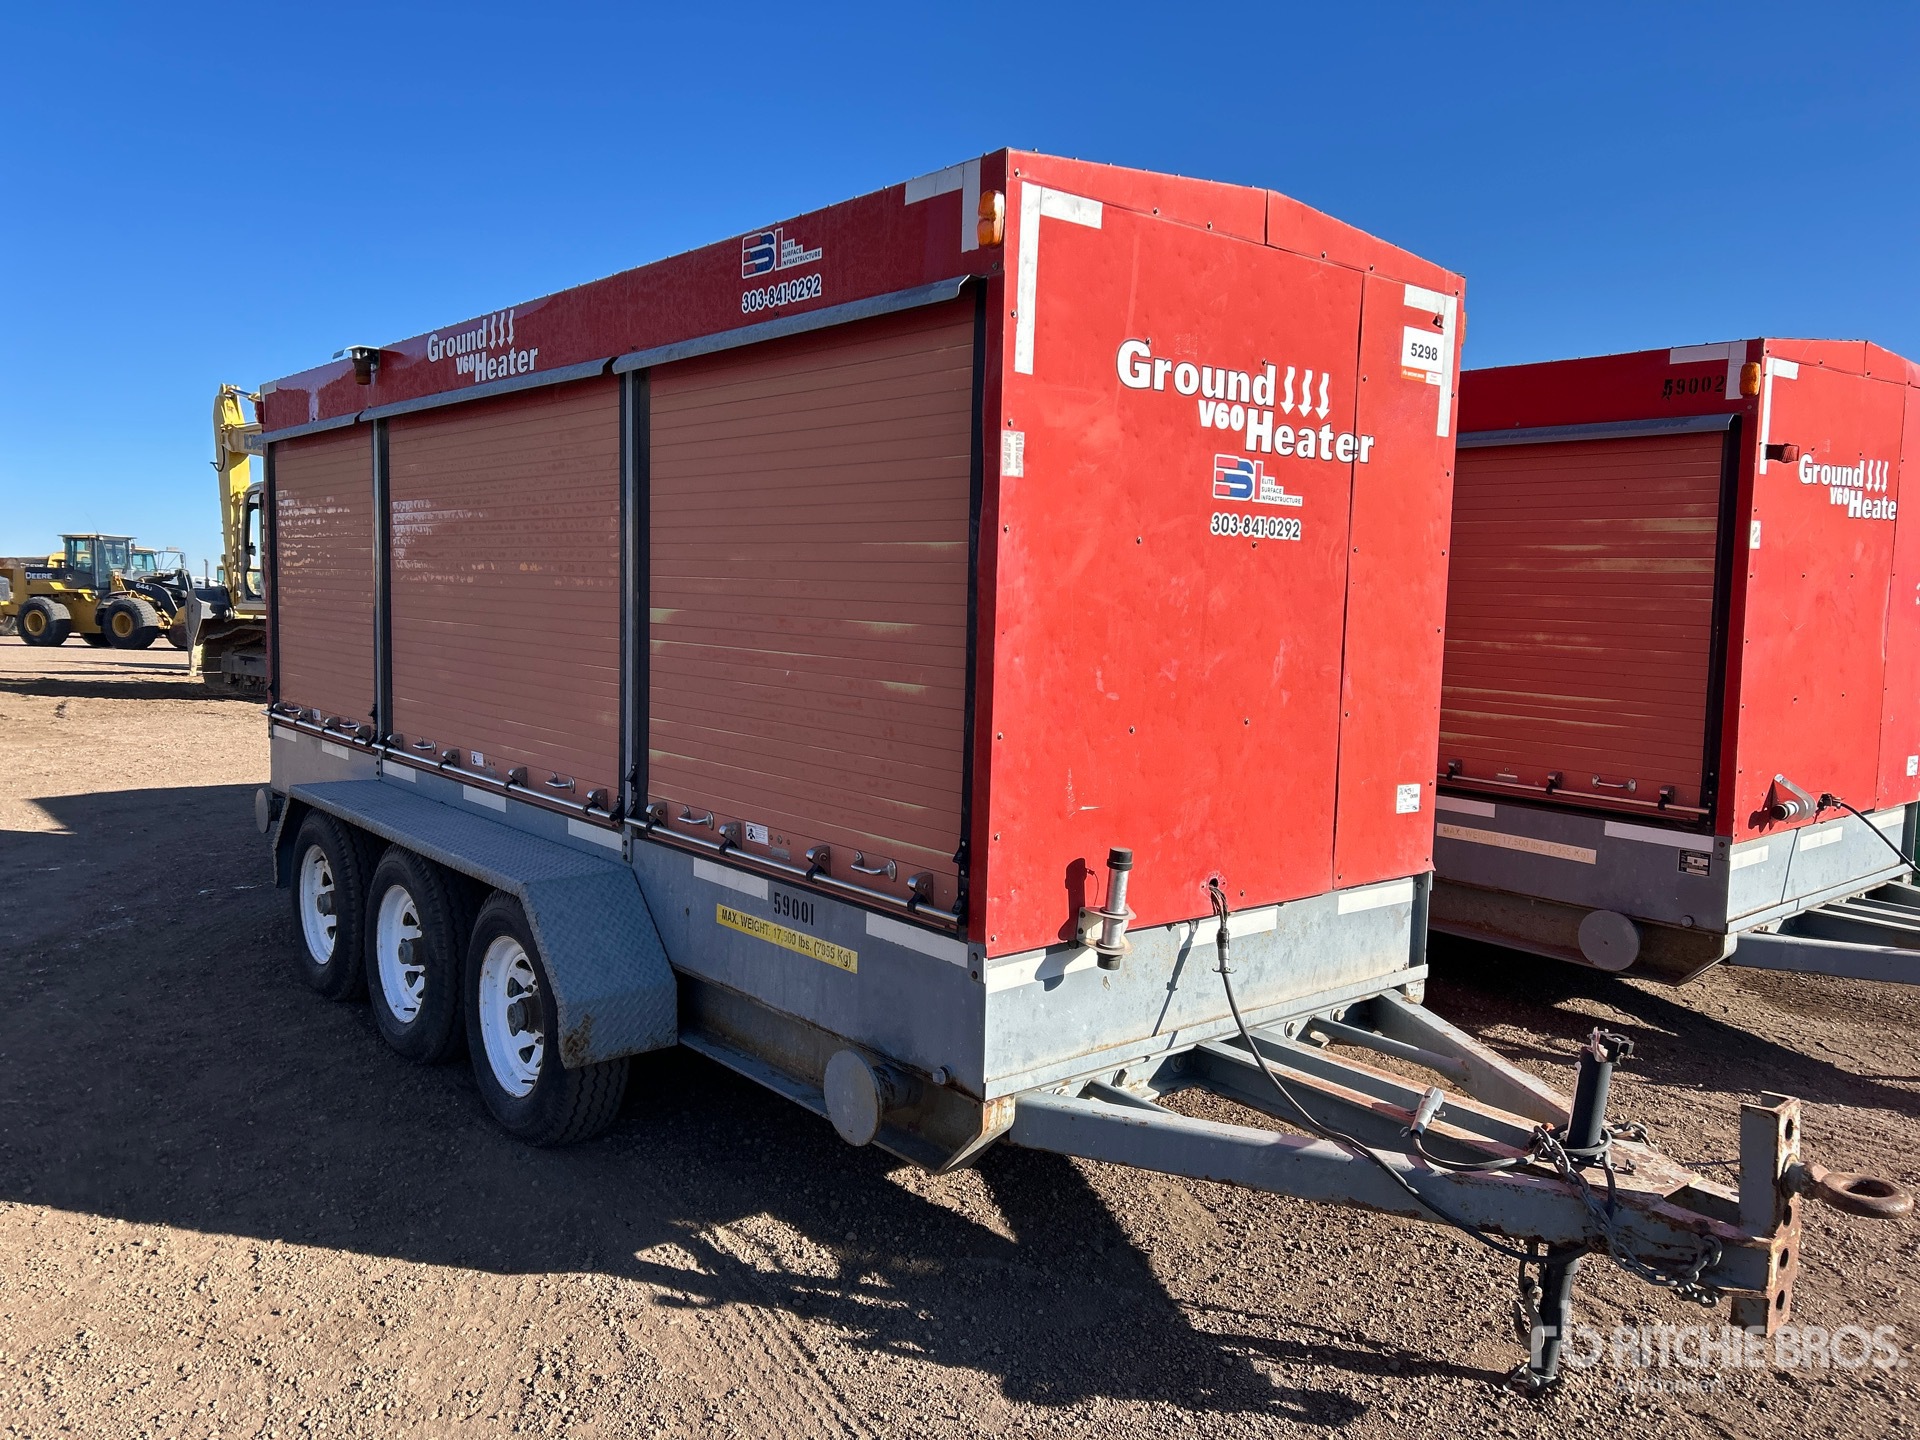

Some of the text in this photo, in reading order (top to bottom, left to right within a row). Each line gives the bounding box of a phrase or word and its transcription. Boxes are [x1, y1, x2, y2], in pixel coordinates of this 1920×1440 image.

[782, 247, 802, 259] SURFACE
[782, 250, 821, 266] INFRASTRUCTURE
[427, 318, 488, 363] Ground
[1410, 342, 1438, 361] 5298
[455, 347, 539, 383] V60 Heater
[1116, 338, 1278, 406] Ground
[1662, 375, 1725, 400] 59002
[1198, 398, 1376, 464] V60 Heater
[1798, 453, 1865, 488] Ground
[1261, 486, 1282, 494] SURFACE
[1261, 494, 1302, 505] INFRASTRUCTURE
[1829, 486, 1849, 506] V60
[25, 572, 53, 580] DEERE
[773, 892, 814, 926] 59001
[721, 908, 739, 925] MAX.
[740, 915, 771, 937] WEIGHT:
[798, 935, 812, 951] lbs.
[837, 949, 852, 967] Kg)
